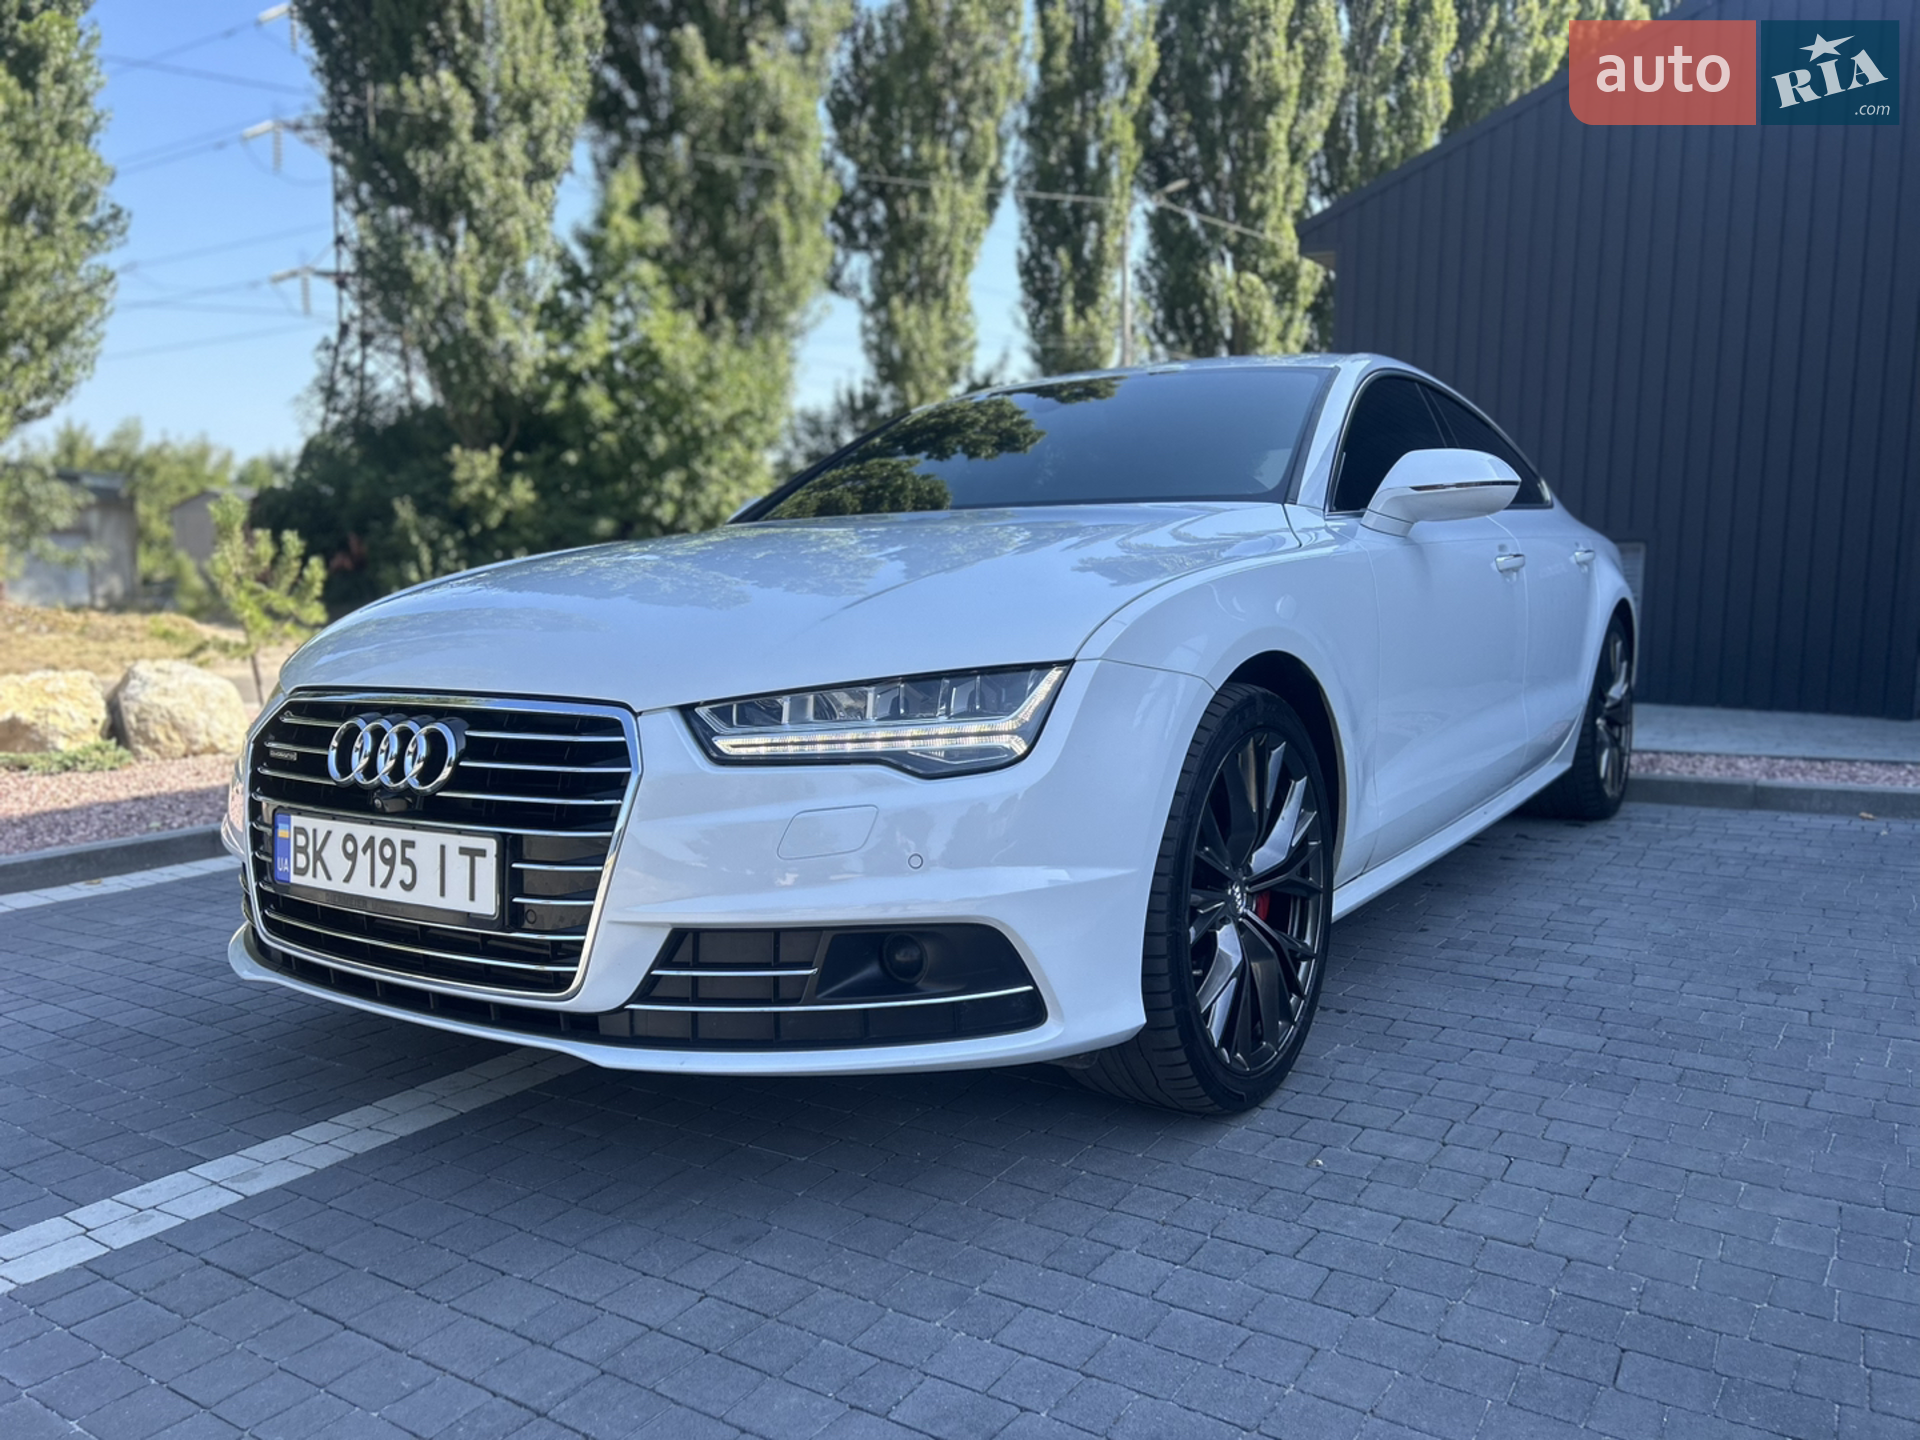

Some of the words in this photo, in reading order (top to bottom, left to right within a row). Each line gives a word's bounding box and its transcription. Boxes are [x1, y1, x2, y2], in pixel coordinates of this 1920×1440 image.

[277, 857, 290, 873] UA
[293, 826, 333, 882] BK
[341, 833, 417, 893] 9195
[439, 844, 487, 902] IT
